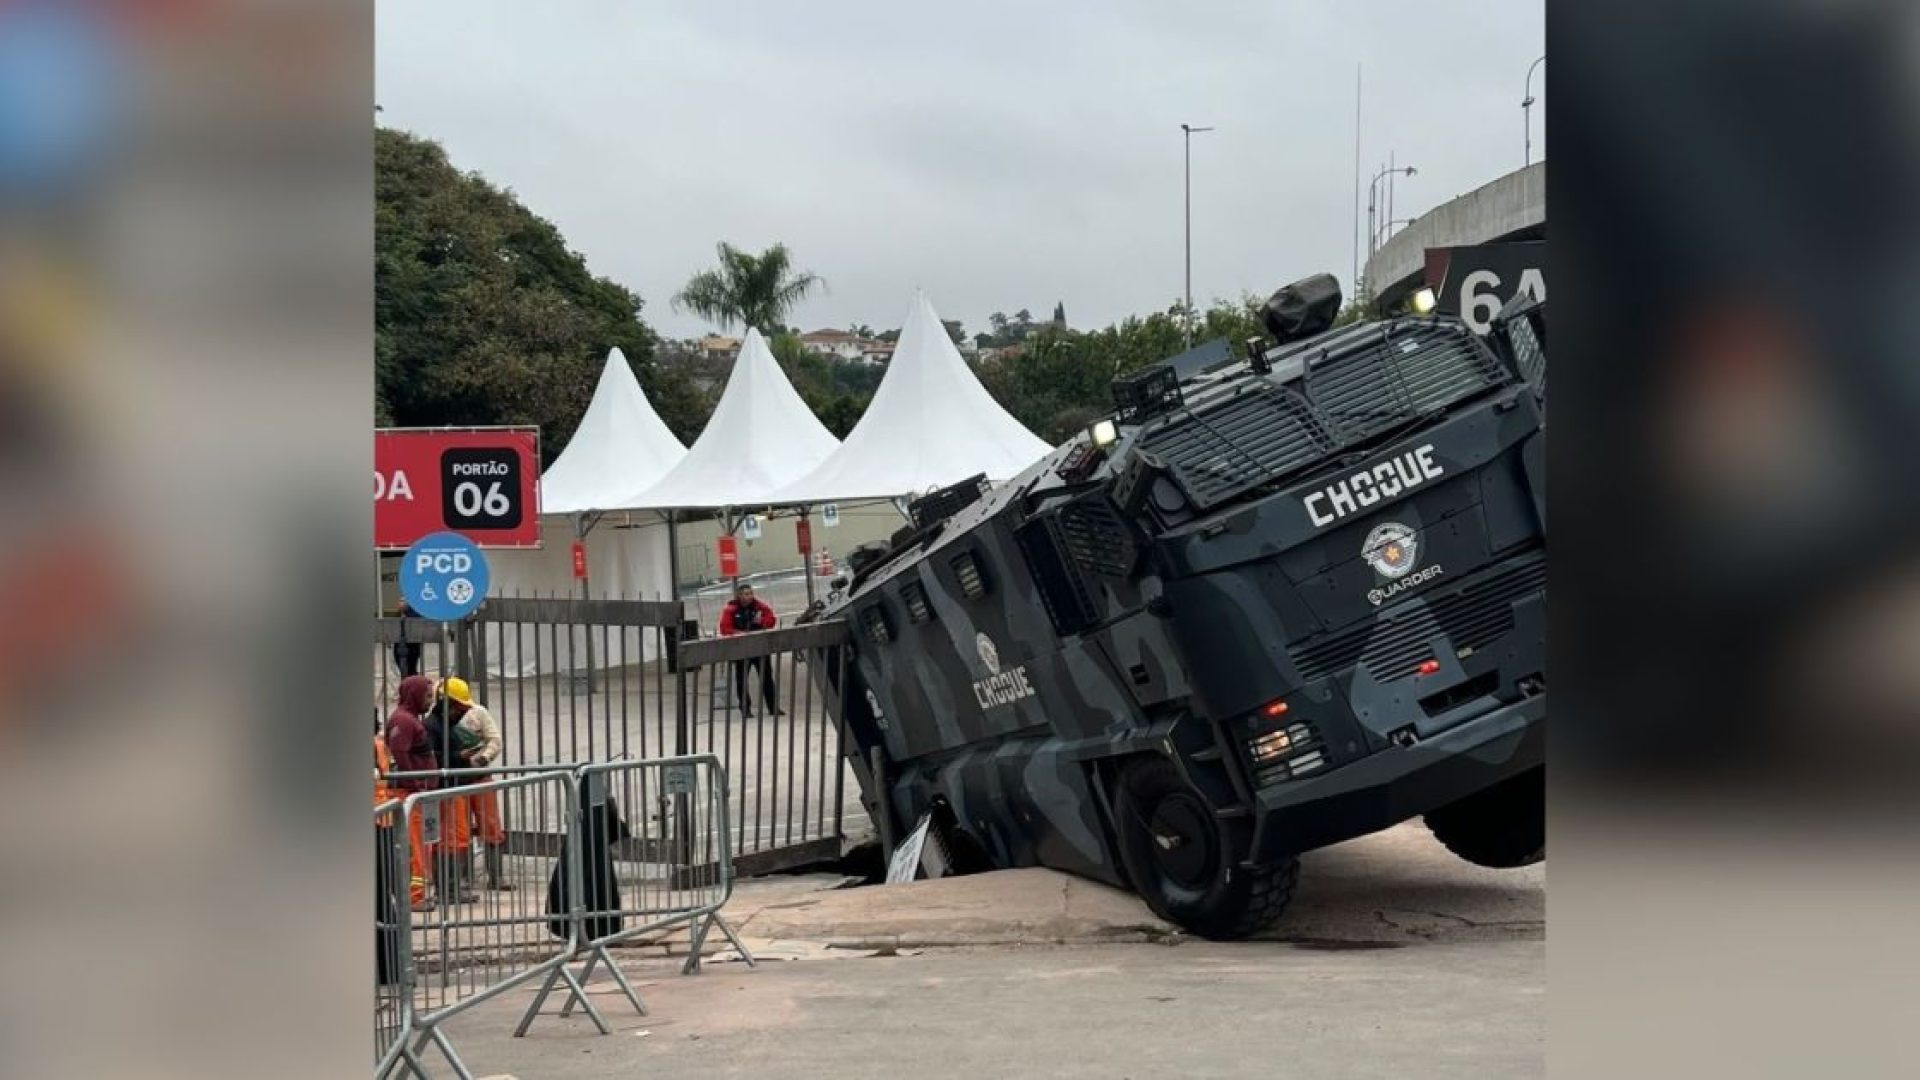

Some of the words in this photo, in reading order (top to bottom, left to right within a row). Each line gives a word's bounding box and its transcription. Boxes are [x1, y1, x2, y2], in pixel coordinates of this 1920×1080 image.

[453, 461, 508, 475] PORTÃO
[1304, 444, 1443, 526] CHOQUE
[454, 482, 510, 516] 06
[416, 553, 472, 574] PCD
